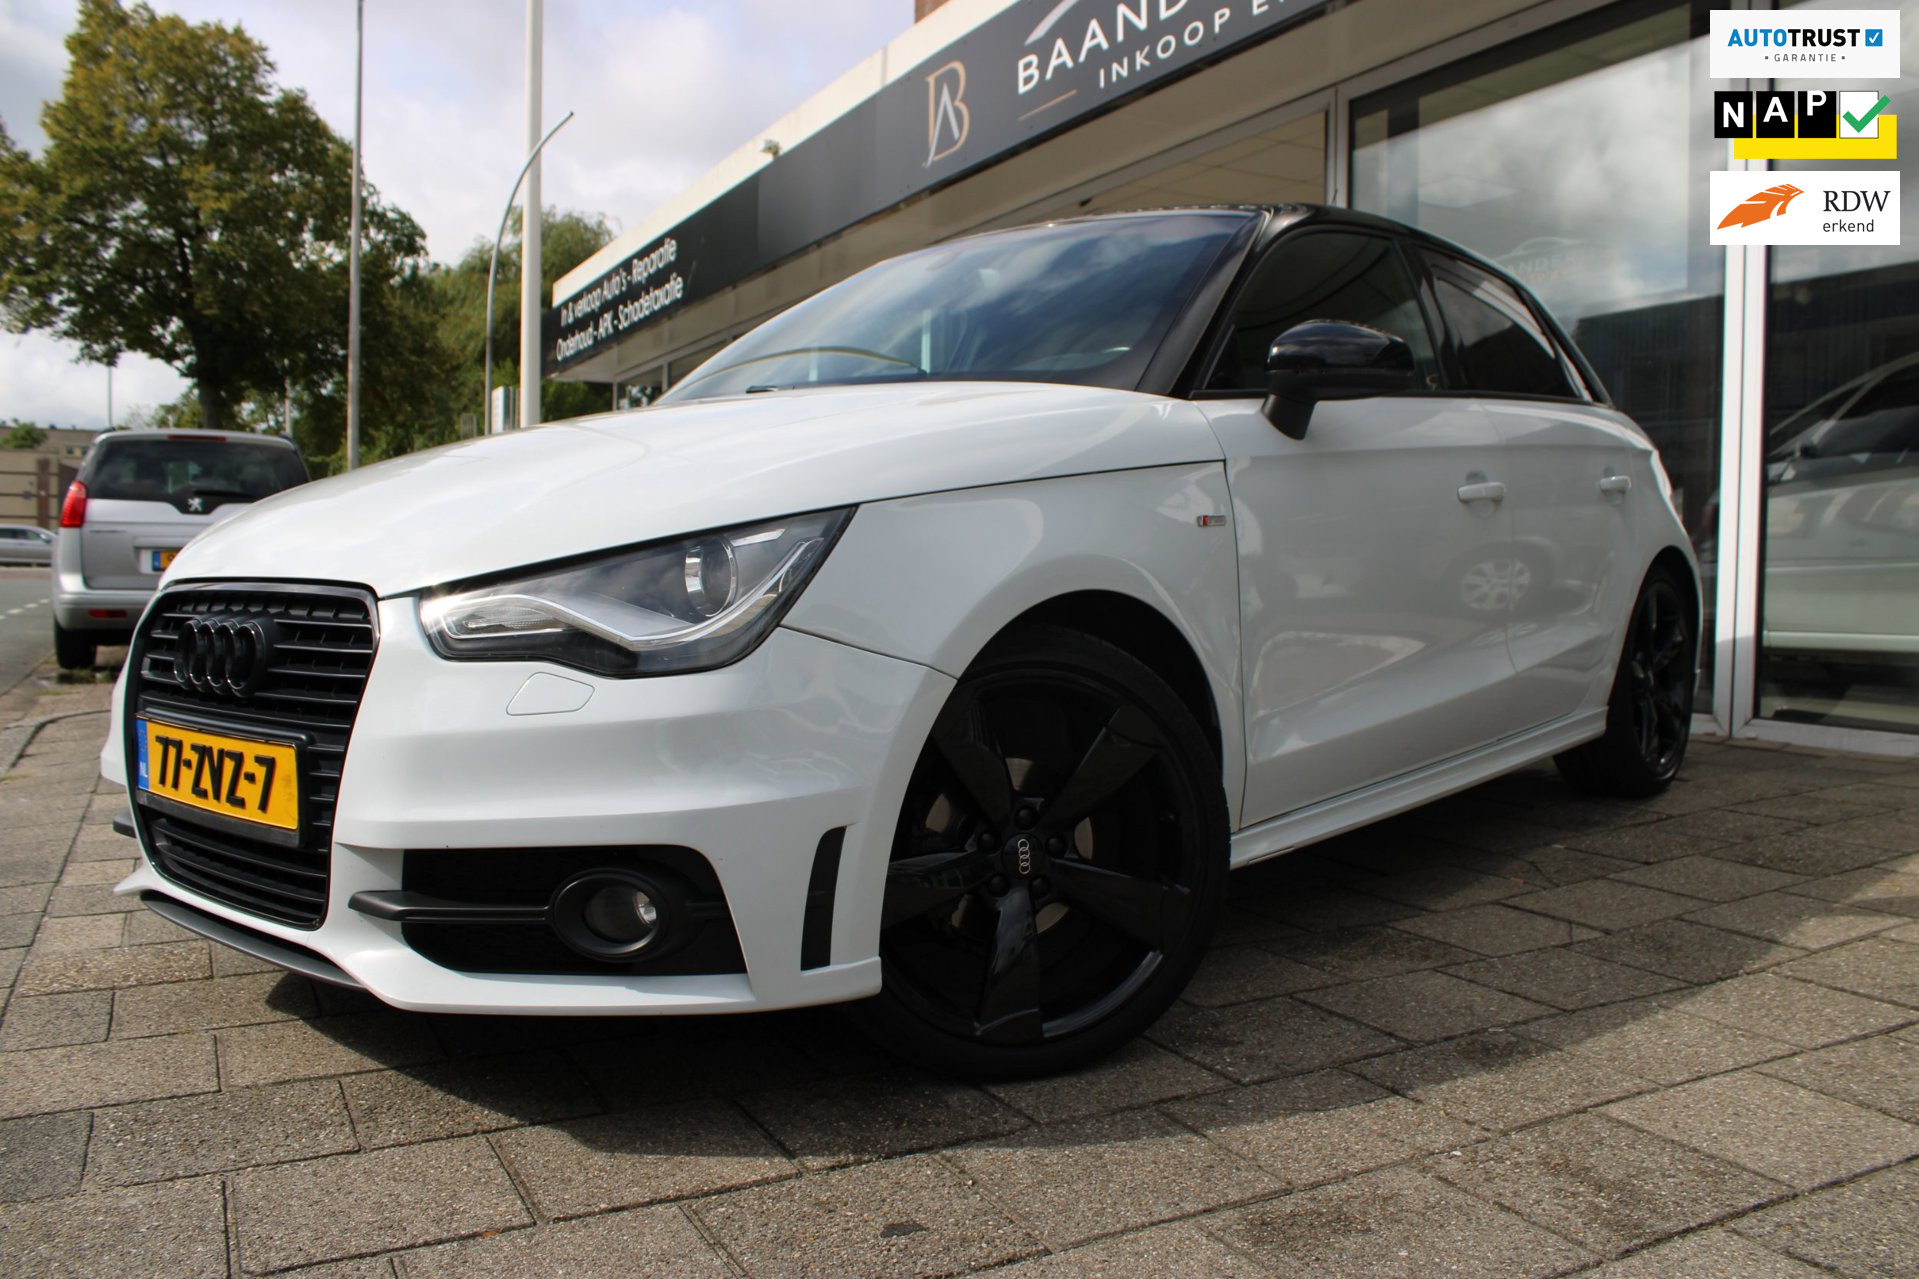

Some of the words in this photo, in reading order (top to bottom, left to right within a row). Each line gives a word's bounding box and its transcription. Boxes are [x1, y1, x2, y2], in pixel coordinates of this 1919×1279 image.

[1099, 8, 1231, 89] INKOOP
[632, 237, 678, 284] Reparatie
[598, 310, 614, 340] APK
[619, 272, 684, 331] Schadetaxatie
[156, 735, 276, 814] 77-ZNZ-7
